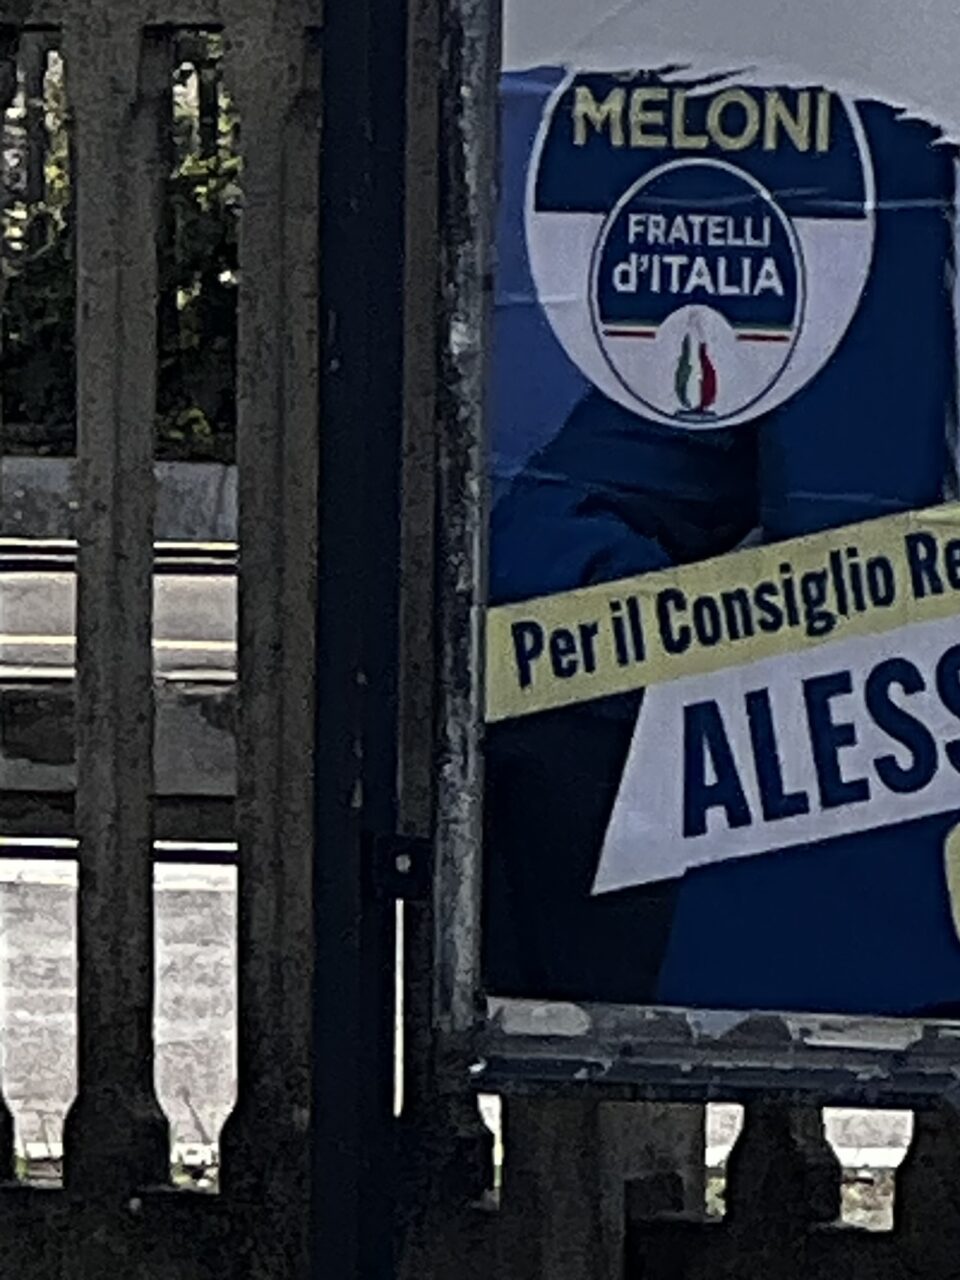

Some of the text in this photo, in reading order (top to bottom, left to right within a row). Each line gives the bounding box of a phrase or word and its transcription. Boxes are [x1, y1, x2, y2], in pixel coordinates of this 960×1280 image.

[571, 86, 830, 152] MELONI
[628, 214, 771, 247] FRATELLI
[512, 617, 598, 690] Per
[607, 600, 646, 663] il
[655, 555, 896, 655] Consiglio
